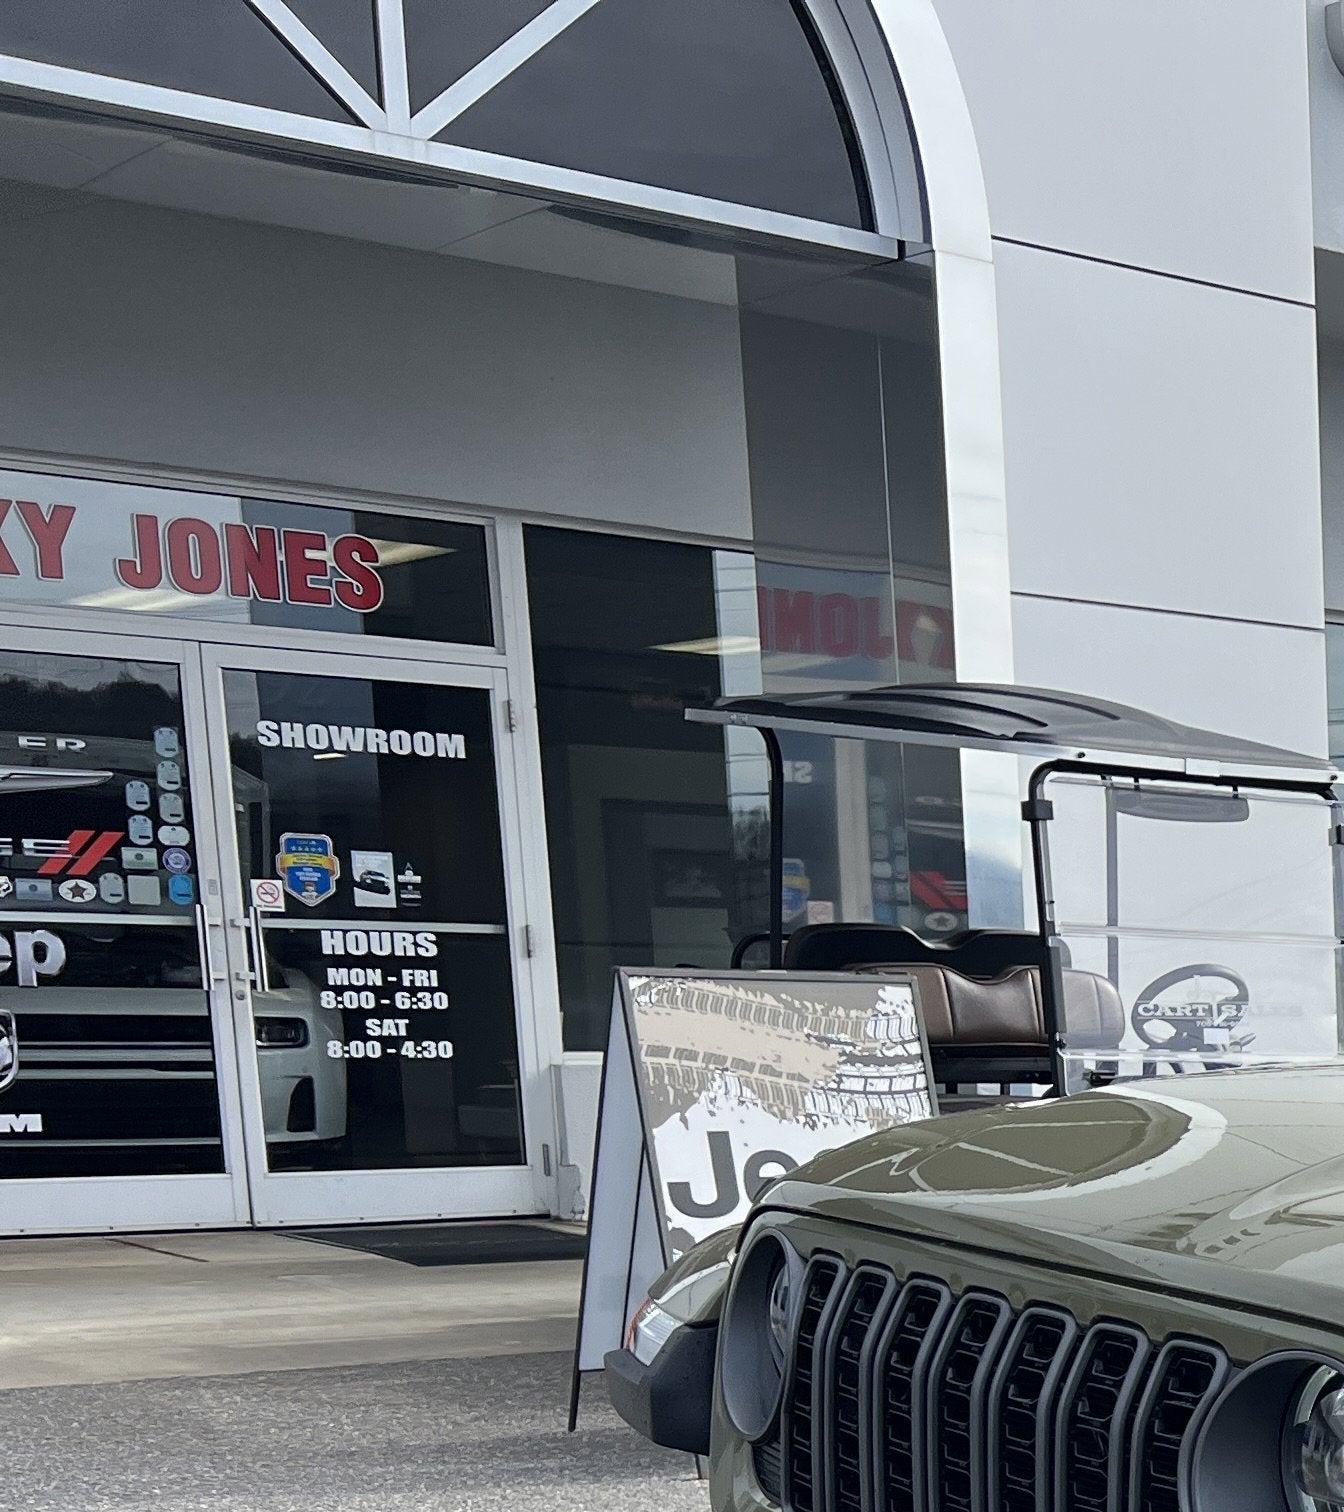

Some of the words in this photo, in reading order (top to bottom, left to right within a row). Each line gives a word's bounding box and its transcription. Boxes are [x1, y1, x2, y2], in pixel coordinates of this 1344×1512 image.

[114, 513, 384, 612] JONES
[256, 719, 467, 759] SHOWROOM
[0, 837, 73, 858] E
[320, 929, 439, 958] HOURS
[0, 929, 67, 988] p
[326, 967, 383, 987] MON
[401, 969, 439, 988] FRI
[320, 990, 376, 1010] 8:00
[394, 991, 449, 1010] 6:30
[1137, 1003, 1209, 1017] CART
[365, 1018, 410, 1037] SAT
[326, 1040, 382, 1059] 8:00
[400, 1040, 454, 1059] 4:30
